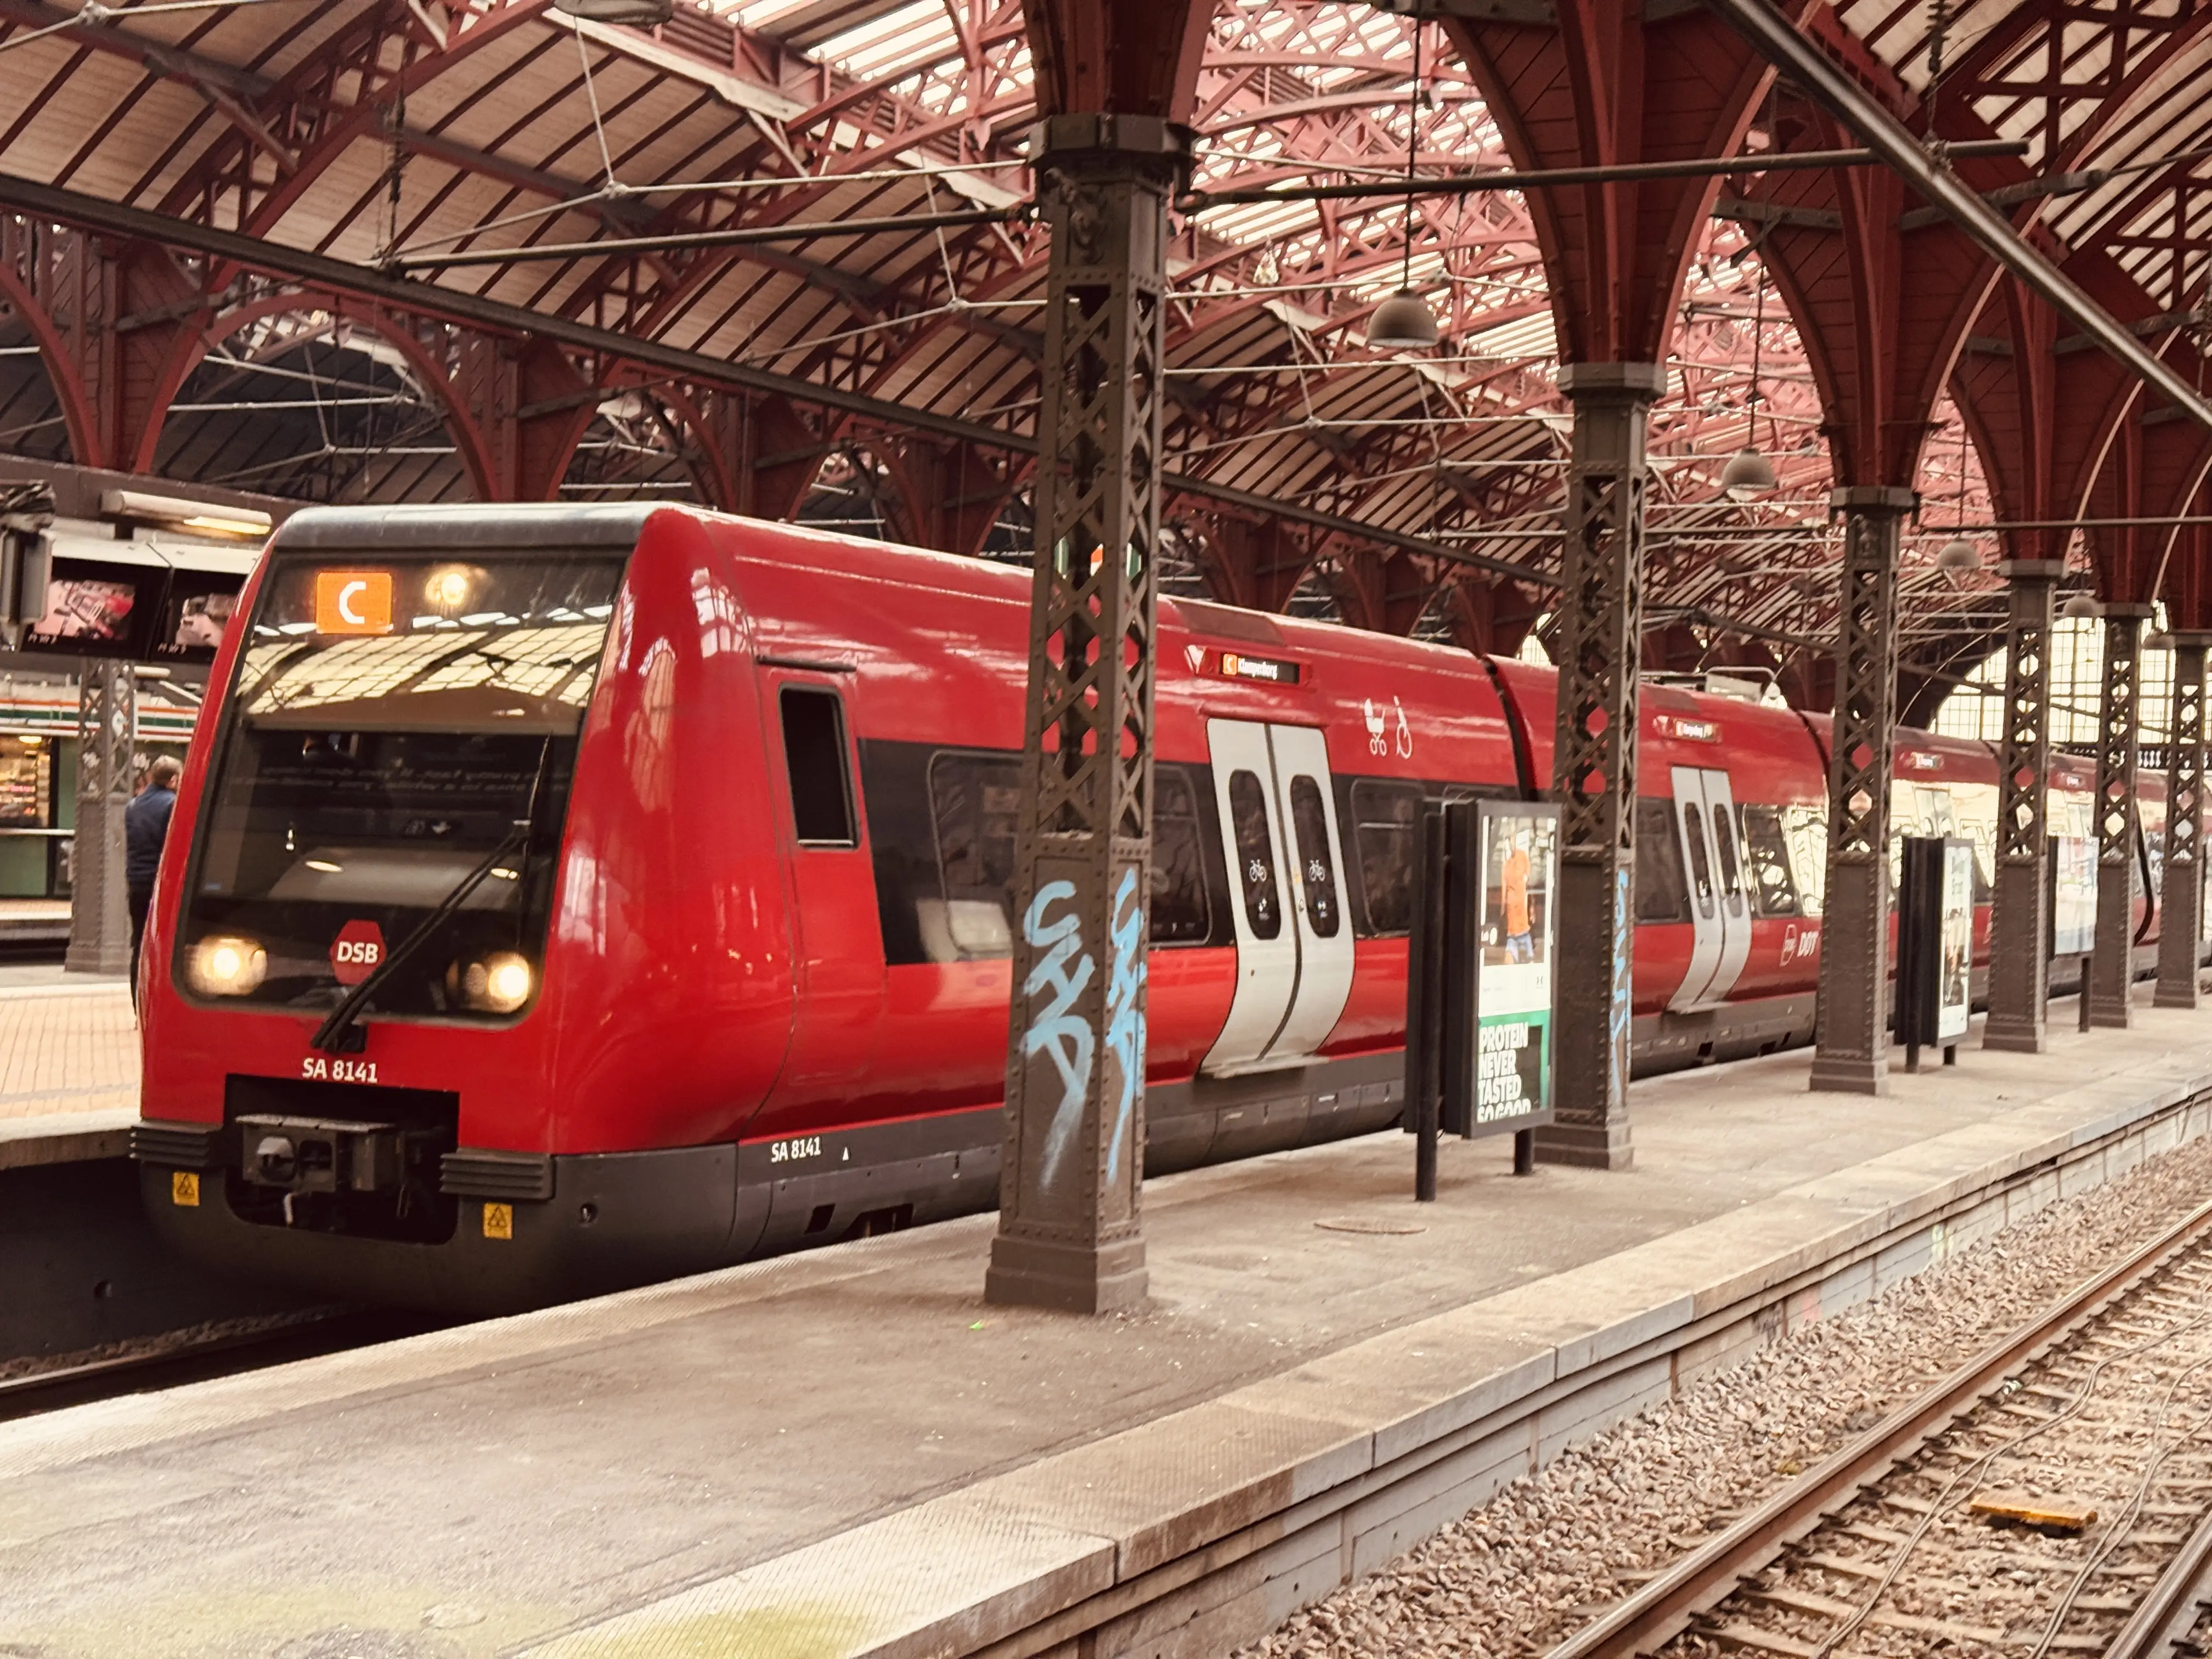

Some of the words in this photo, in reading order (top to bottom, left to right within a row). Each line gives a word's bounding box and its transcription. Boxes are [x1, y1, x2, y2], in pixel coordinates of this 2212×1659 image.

[338, 580, 366, 624] C
[337, 941, 379, 964] DSB
[1479, 1022, 1528, 1054] PROTEIN
[302, 1057, 328, 1080] SA
[332, 1060, 378, 1084] 8141
[1479, 1048, 1517, 1080] NEVER
[1477, 1074, 1522, 1106] TASTED
[771, 1142, 788, 1163] SA
[791, 1136, 821, 1159] 8141
